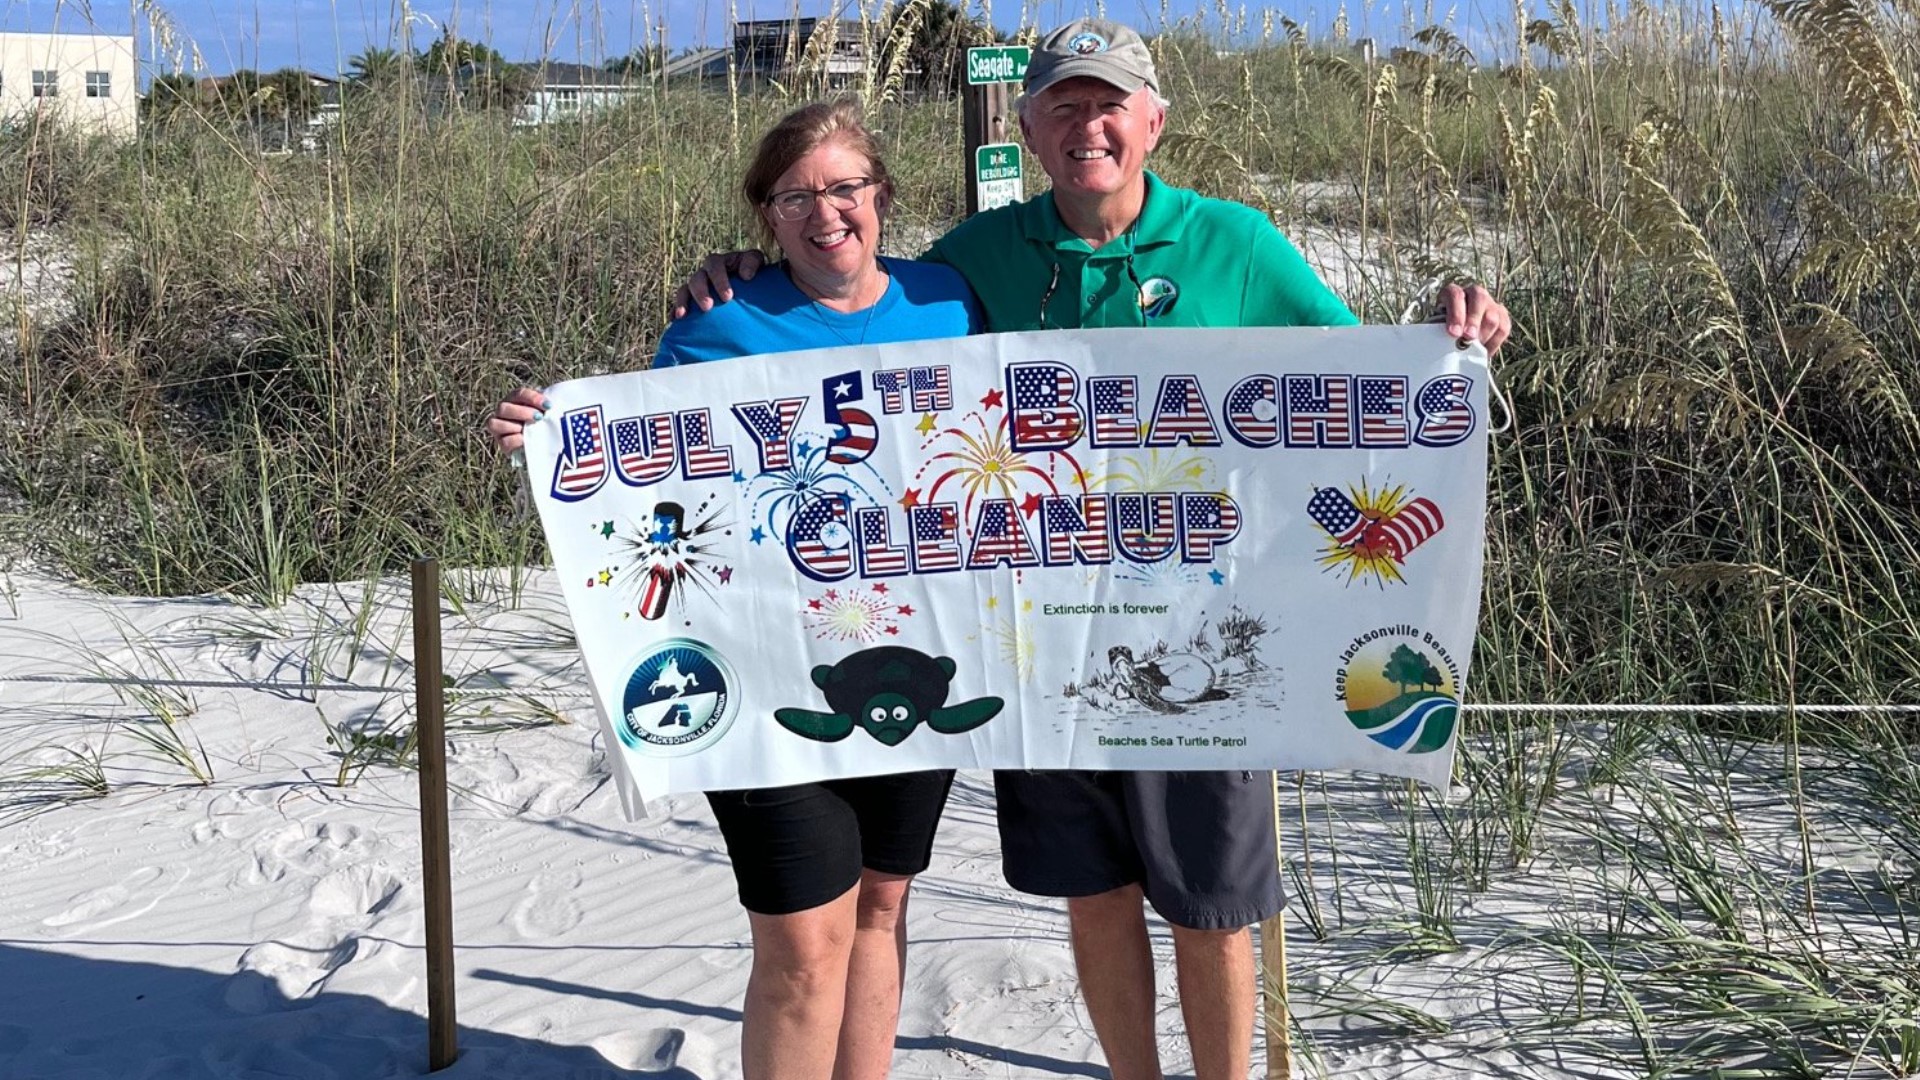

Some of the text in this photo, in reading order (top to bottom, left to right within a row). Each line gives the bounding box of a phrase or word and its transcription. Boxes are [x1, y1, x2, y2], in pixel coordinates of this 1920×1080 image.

[970, 52, 1014, 80] Seagate
[981, 166, 1018, 180] REBUILDING
[550, 396, 810, 502] JULY
[1005, 360, 1477, 452] BEACHES
[786, 491, 1242, 582] CLEANUP
[1043, 603, 1169, 615] Extinction is forever
[1334, 624, 1461, 702] Keep Jacksonville Beautiful
[626, 693, 726, 745] CITY OF JACKSONVILLE, FLORIDA
[1098, 736, 1247, 747] Beaches Sea Turtle Patrol
